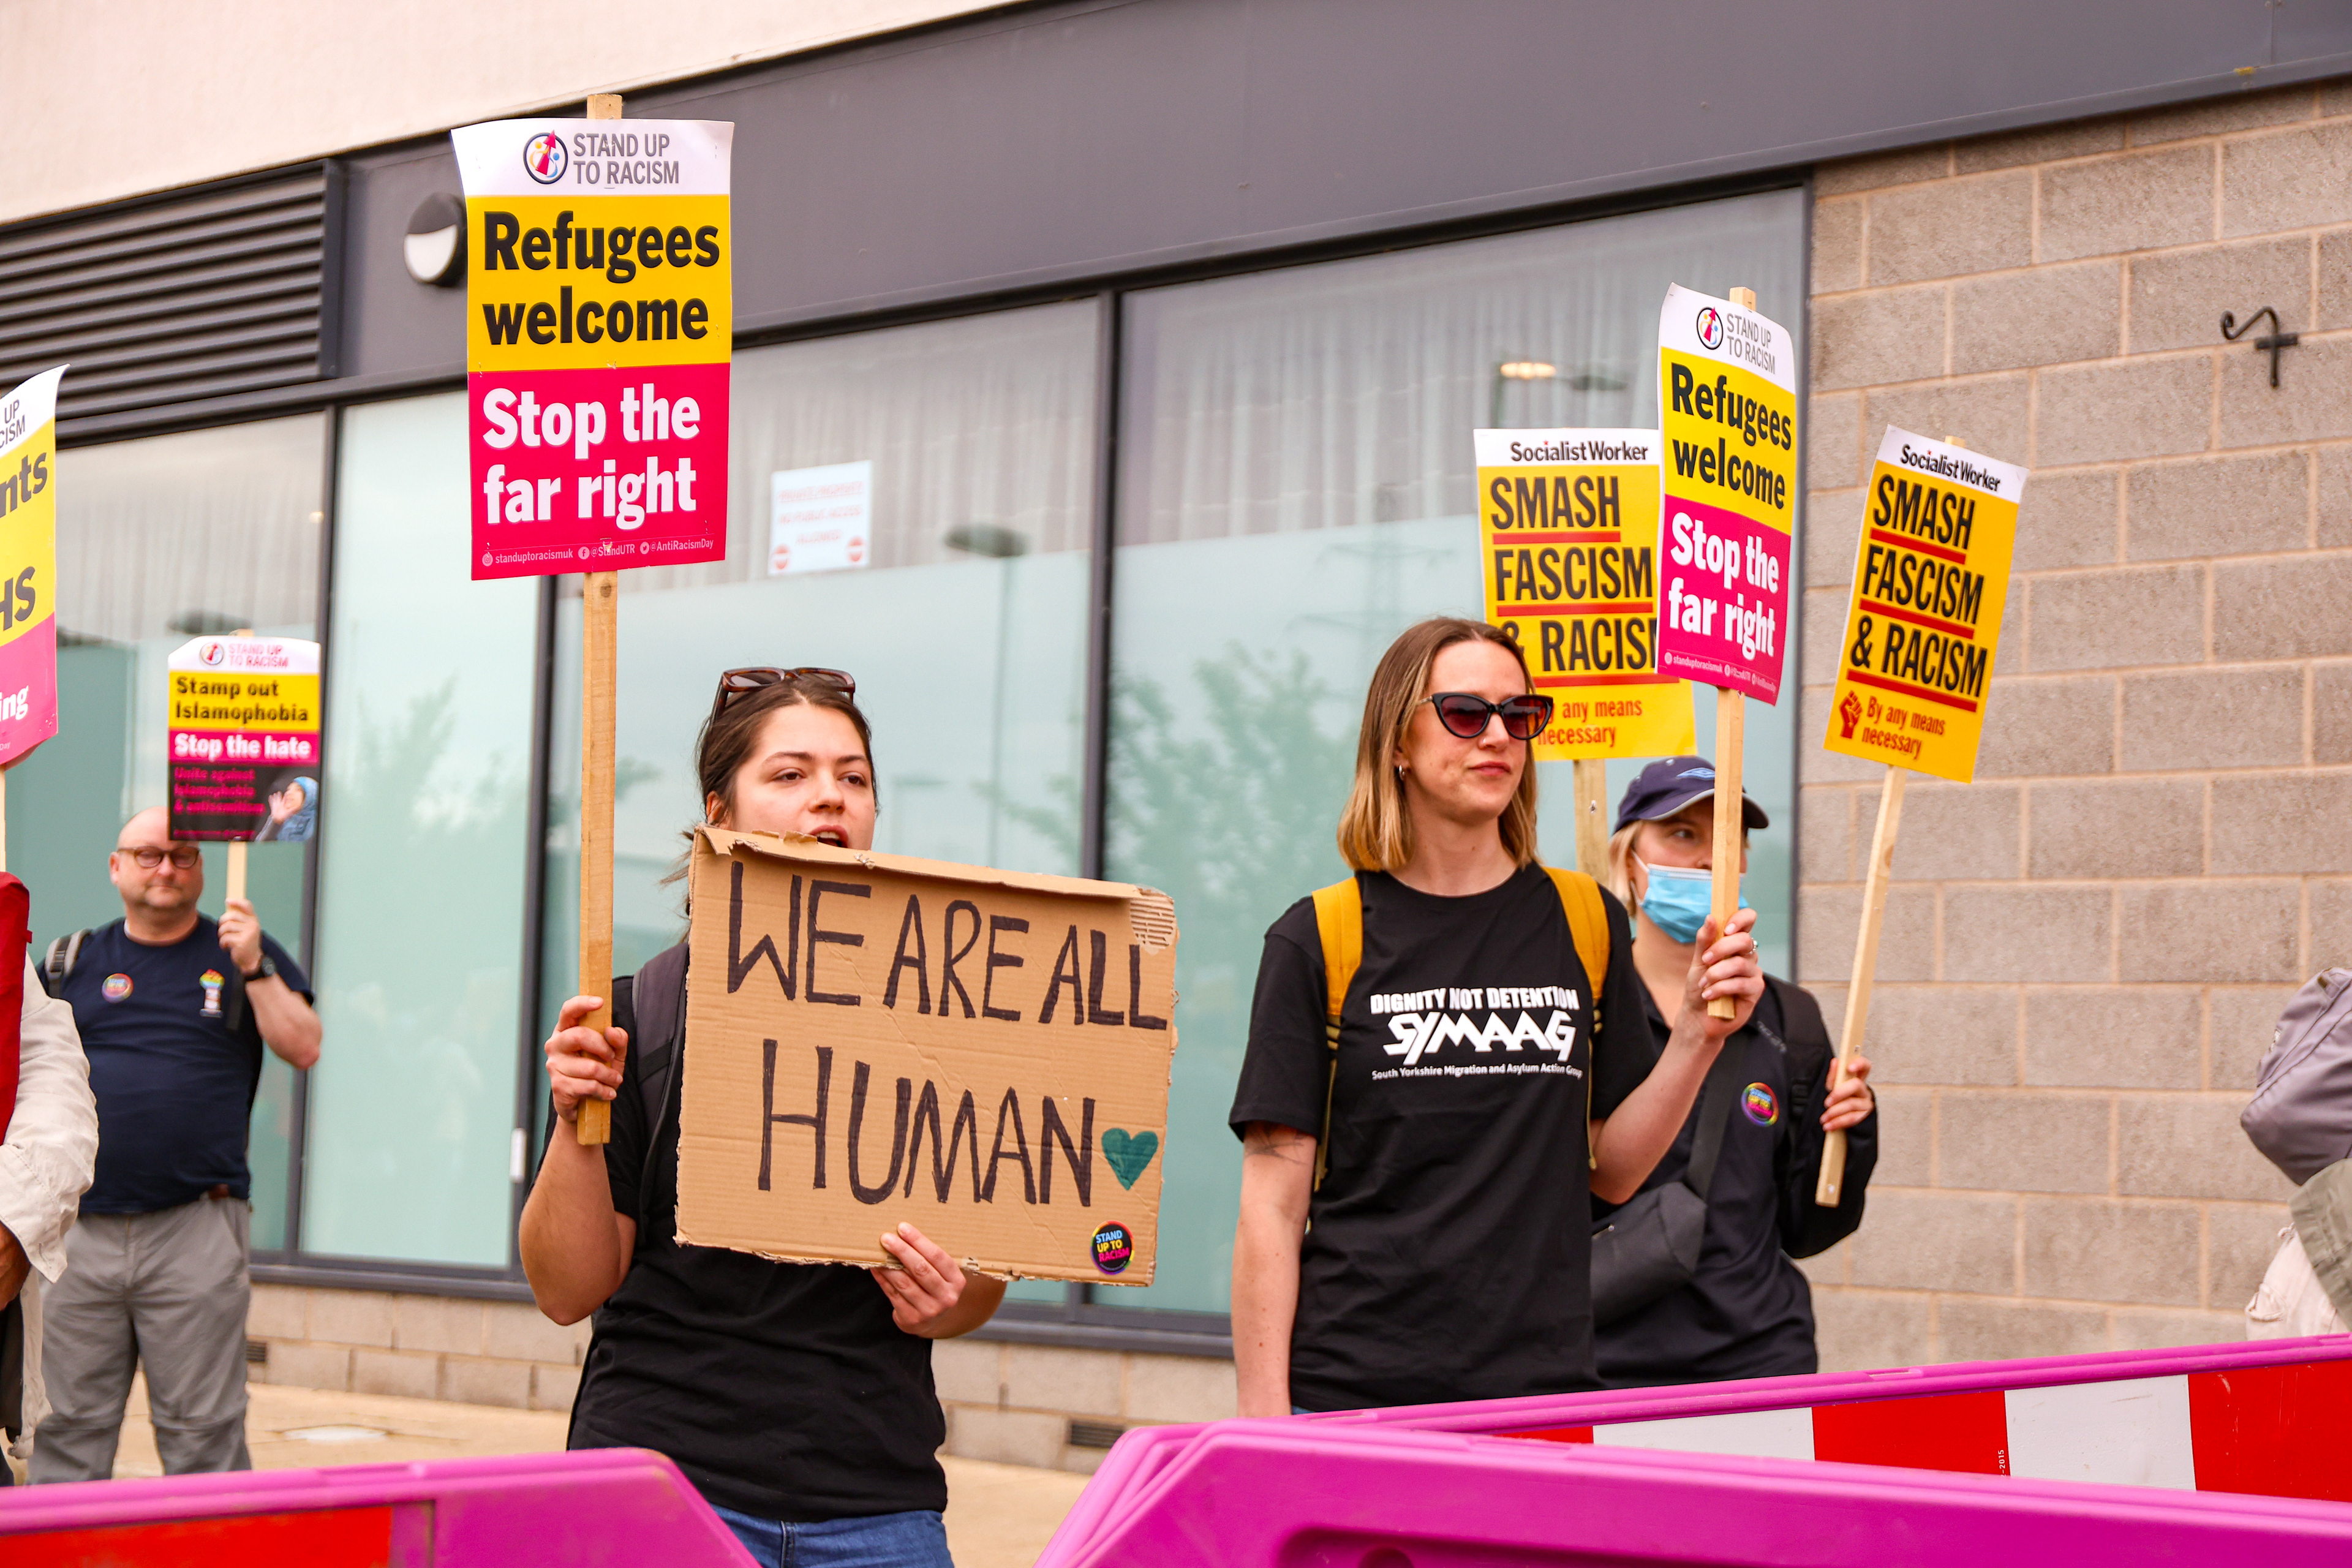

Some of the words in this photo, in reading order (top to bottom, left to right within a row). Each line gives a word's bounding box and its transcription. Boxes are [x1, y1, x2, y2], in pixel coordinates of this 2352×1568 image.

[573, 132, 639, 157] STAND
[644, 132, 670, 157] UP
[573, 160, 600, 184] TO
[606, 160, 679, 184] RACISM
[484, 210, 720, 284] Refugees
[482, 285, 709, 345] welcome
[1727, 313, 1758, 342] STAND
[1760, 326, 1771, 349] UP
[1727, 336, 1743, 358] TO
[1746, 342, 1775, 374] RACISM
[5, 399, 20, 424] UP
[483, 388, 606, 459] Stop
[620, 383, 700, 442] the
[1671, 362, 1792, 450] Refugees
[1510, 440, 1587, 461] Socialist
[1588, 440, 1648, 461] Worker
[1900, 443, 1959, 479] Socialist
[1960, 460, 2000, 492] Worker
[1672, 437, 1785, 509] welcome
[483, 464, 560, 524] far
[578, 456, 696, 530] right
[1490, 475, 1620, 529] SMASH
[1873, 473, 1975, 550] SMASH
[496, 549, 573, 564] standuptoracismuk
[650, 538, 714, 552] @AntiRacismDay
[1670, 512, 1740, 589] Stop
[1745, 535, 1779, 594] the
[1494, 546, 1653, 600] FASCISM
[1862, 543, 1985, 625] FASCISM
[1668, 577, 1717, 636] far
[1725, 593, 1775, 660] right
[229, 644, 263, 655] STAND
[246, 655, 288, 668] RACISM
[1673, 655, 1723, 673] standuptoracismuk
[1850, 614, 1873, 669] &
[1881, 622, 1988, 697] RACISM
[176, 676, 241, 699] Stamp
[247, 680, 279, 696] out
[176, 701, 308, 725] Islamophobia
[1562, 701, 1588, 723] any
[1595, 699, 1642, 717] means
[1867, 695, 1883, 725] By
[1886, 706, 1908, 731] any
[1910, 711, 1946, 736] means
[175, 733, 223, 762] Stop
[226, 734, 261, 760] the
[264, 735, 311, 760] hate
[1538, 726, 1616, 747] necessary
[1862, 726, 1923, 760] necessary
[728, 861, 872, 1007] WE
[883, 894, 1030, 1022] ARE
[1038, 925, 1167, 1030] ALL
[1370, 987, 1446, 1014] DIGNITY
[1449, 987, 1483, 1011] NOT
[1486, 986, 1580, 1011] DETENTION
[1382, 1009, 1577, 1066] SYMAAG
[1371, 1069, 1398, 1080] South
[1400, 1066, 1442, 1079] Yorkshire
[1444, 1064, 1487, 1077] Migration
[1488, 1063, 1506, 1074] and
[1507, 1063, 1539, 1076] Asylum
[1540, 1063, 1565, 1074] Action
[757, 1038, 1096, 1207] HUMAN
[1095, 1229, 1123, 1243] STAND
[1097, 1242, 1109, 1253] UP
[1110, 1239, 1123, 1250] TO
[1098, 1247, 1130, 1262] RACISM
